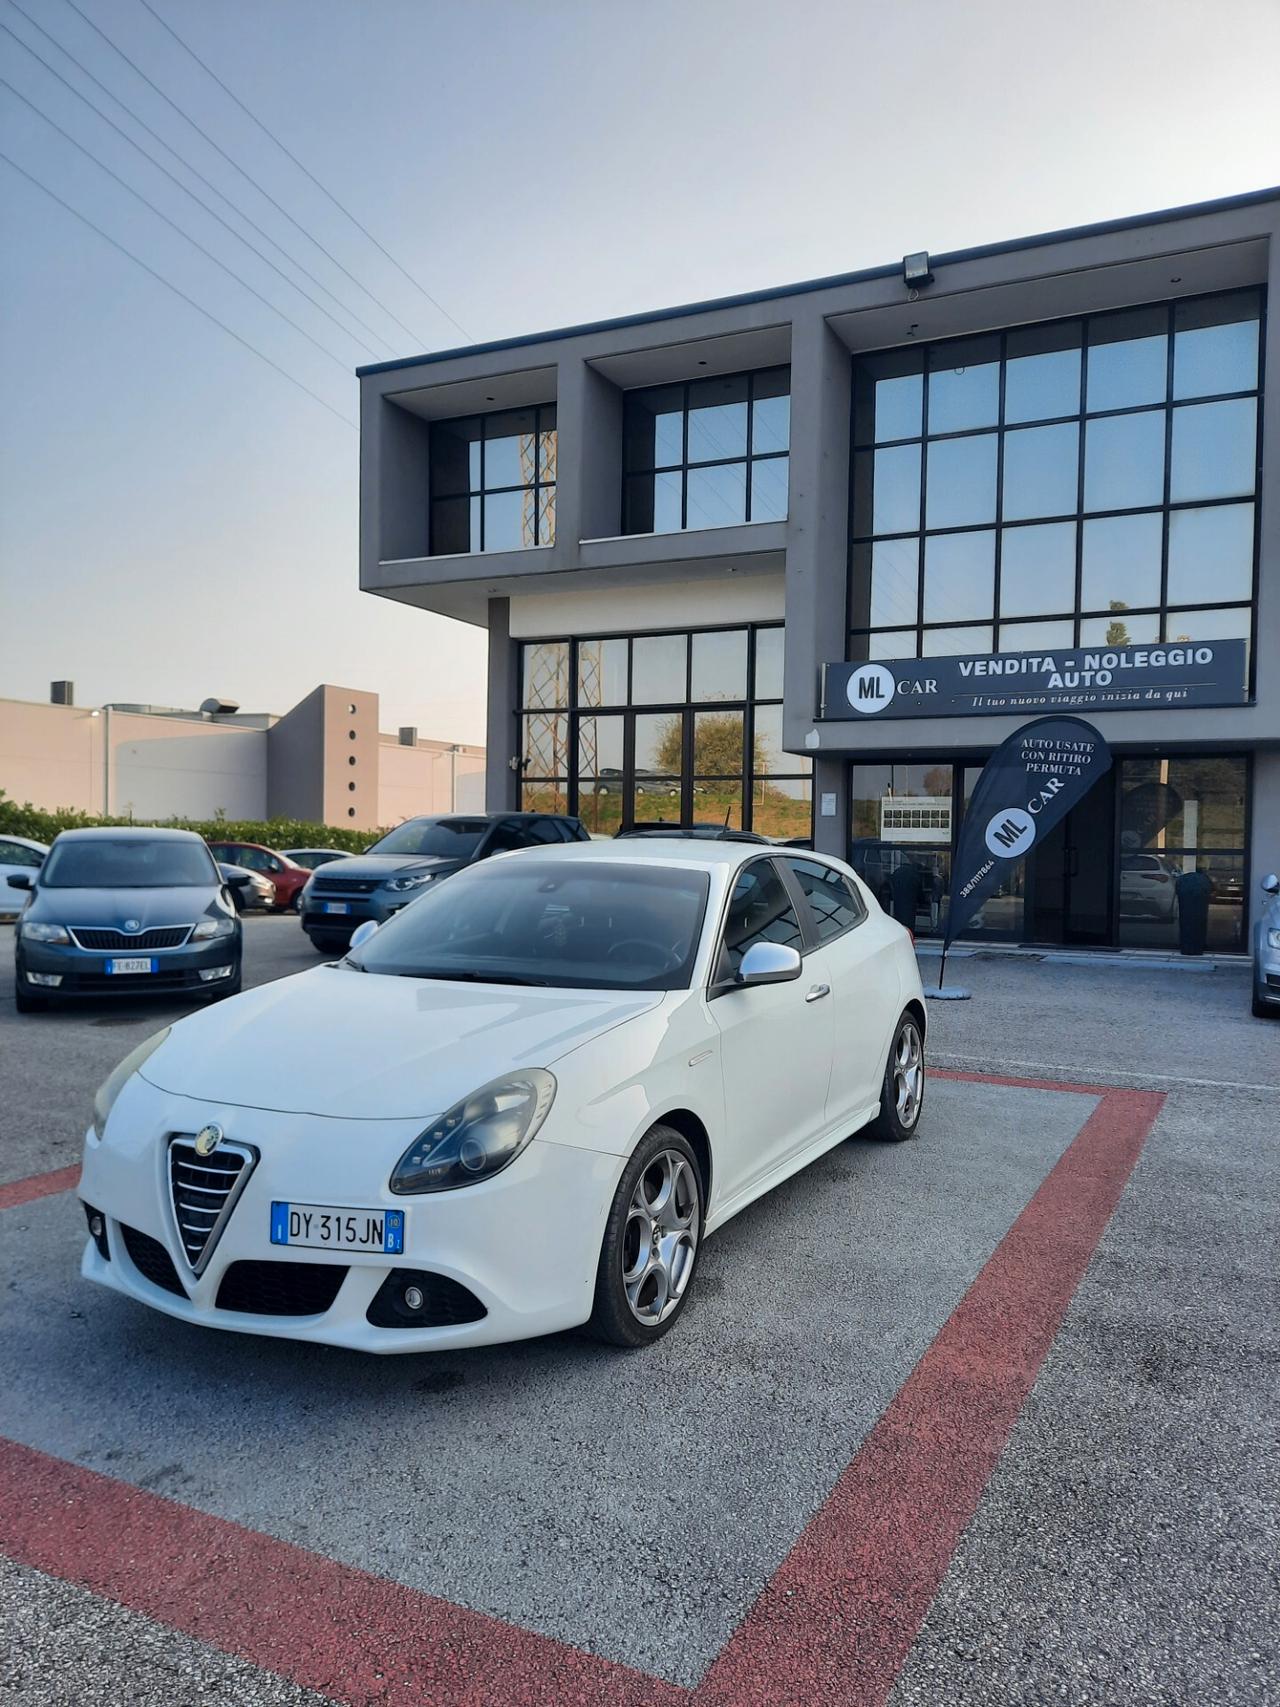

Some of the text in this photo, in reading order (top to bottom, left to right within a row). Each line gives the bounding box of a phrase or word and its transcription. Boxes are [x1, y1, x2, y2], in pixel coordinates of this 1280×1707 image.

[959, 657, 1056, 676] VENDITA
[1084, 648, 1213, 670] NOLEGGIO
[859, 677, 938, 699] ML CAR
[1047, 670, 1113, 688] AUTO
[987, 698, 1006, 706] tuo
[1010, 697, 1046, 705] nuovo
[1051, 692, 1097, 705] viaggio
[1101, 690, 1140, 701] inizia
[1145, 689, 1160, 699] da
[1166, 688, 1188, 701] qui
[1021, 739, 1095, 753] AUTO USATE
[1021, 751, 1091, 764] CON RITIRO
[1025, 763, 1082, 776] PERMUTA
[993, 777, 1065, 849] ML CAR
[290, 1211, 383, 1245] DY 315JN
